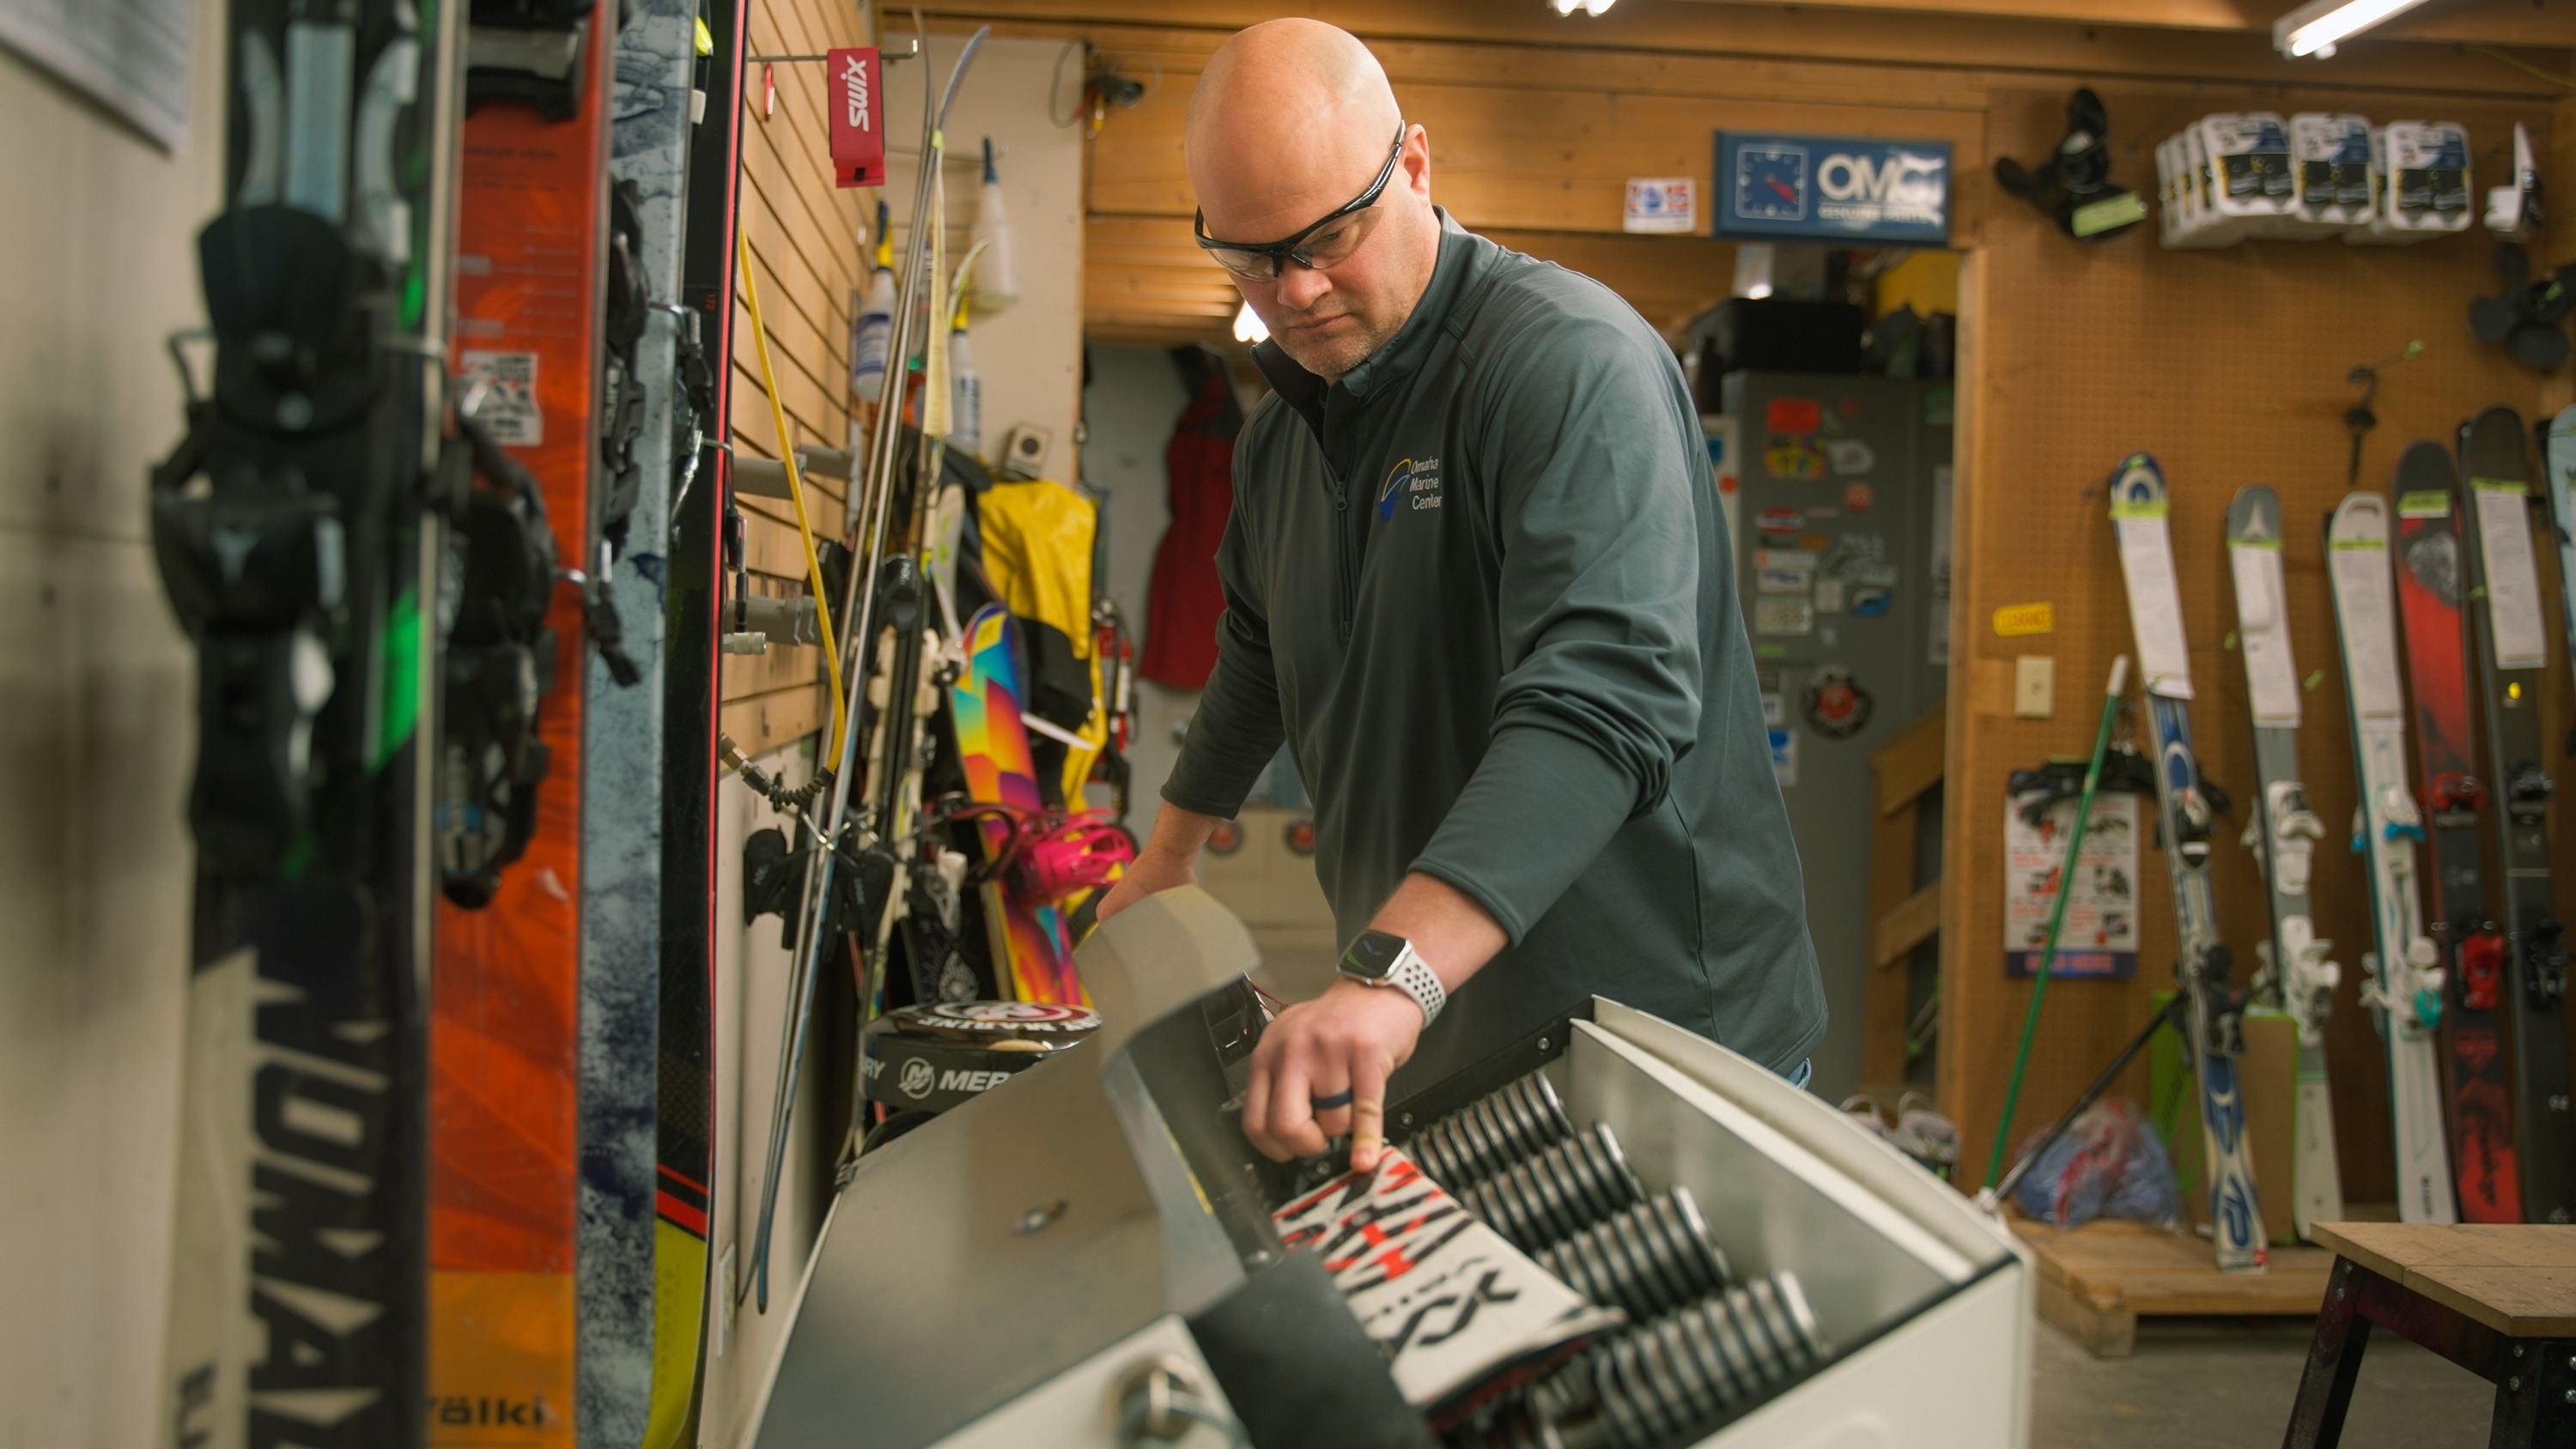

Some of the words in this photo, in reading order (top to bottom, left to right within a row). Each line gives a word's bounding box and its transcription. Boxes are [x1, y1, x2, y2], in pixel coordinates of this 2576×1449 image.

[1411, 456, 1438, 475] Omaha
[1409, 474, 1439, 492] Marine
[1412, 493, 1442, 511] Center
